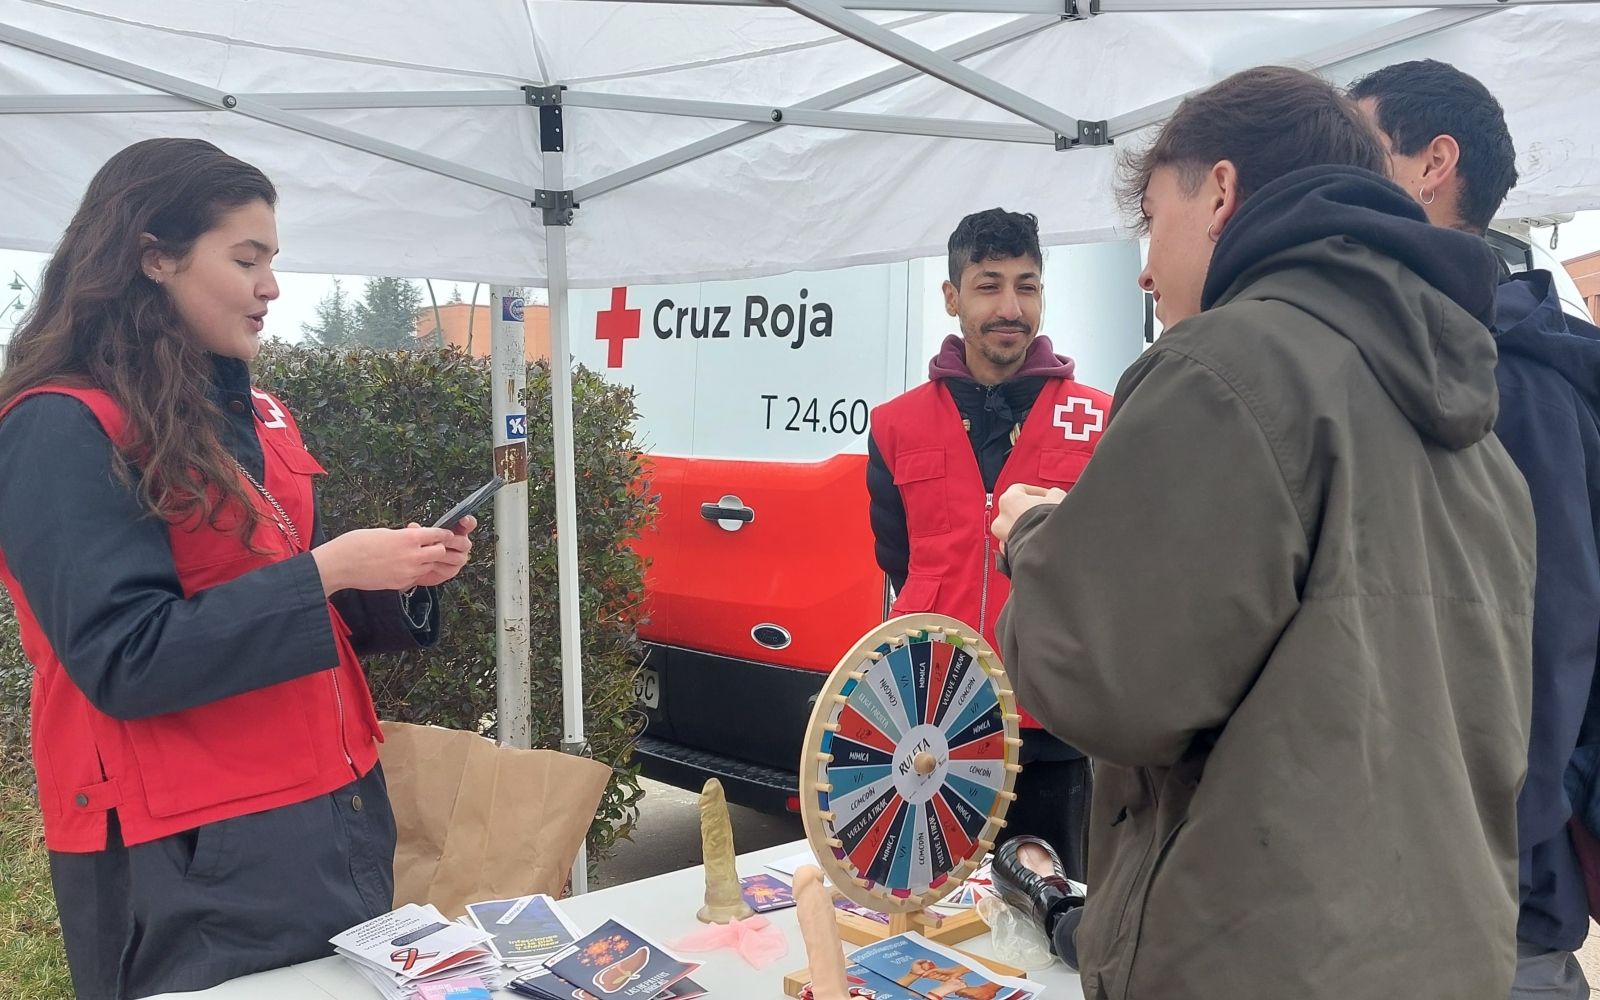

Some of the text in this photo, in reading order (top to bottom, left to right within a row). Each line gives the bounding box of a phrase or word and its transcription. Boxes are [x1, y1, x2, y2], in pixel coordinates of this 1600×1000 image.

[653, 288, 833, 349] Cruz Roja
[761, 395, 869, 435] T 24.60
[942, 680, 956, 706] VUELVE
[953, 653, 966, 675] TIRAR
[846, 819, 868, 839] VUELVE
[871, 798, 888, 816] TIRAR
[928, 814, 939, 835] TIRAR
[934, 841, 945, 867] VUELVE
